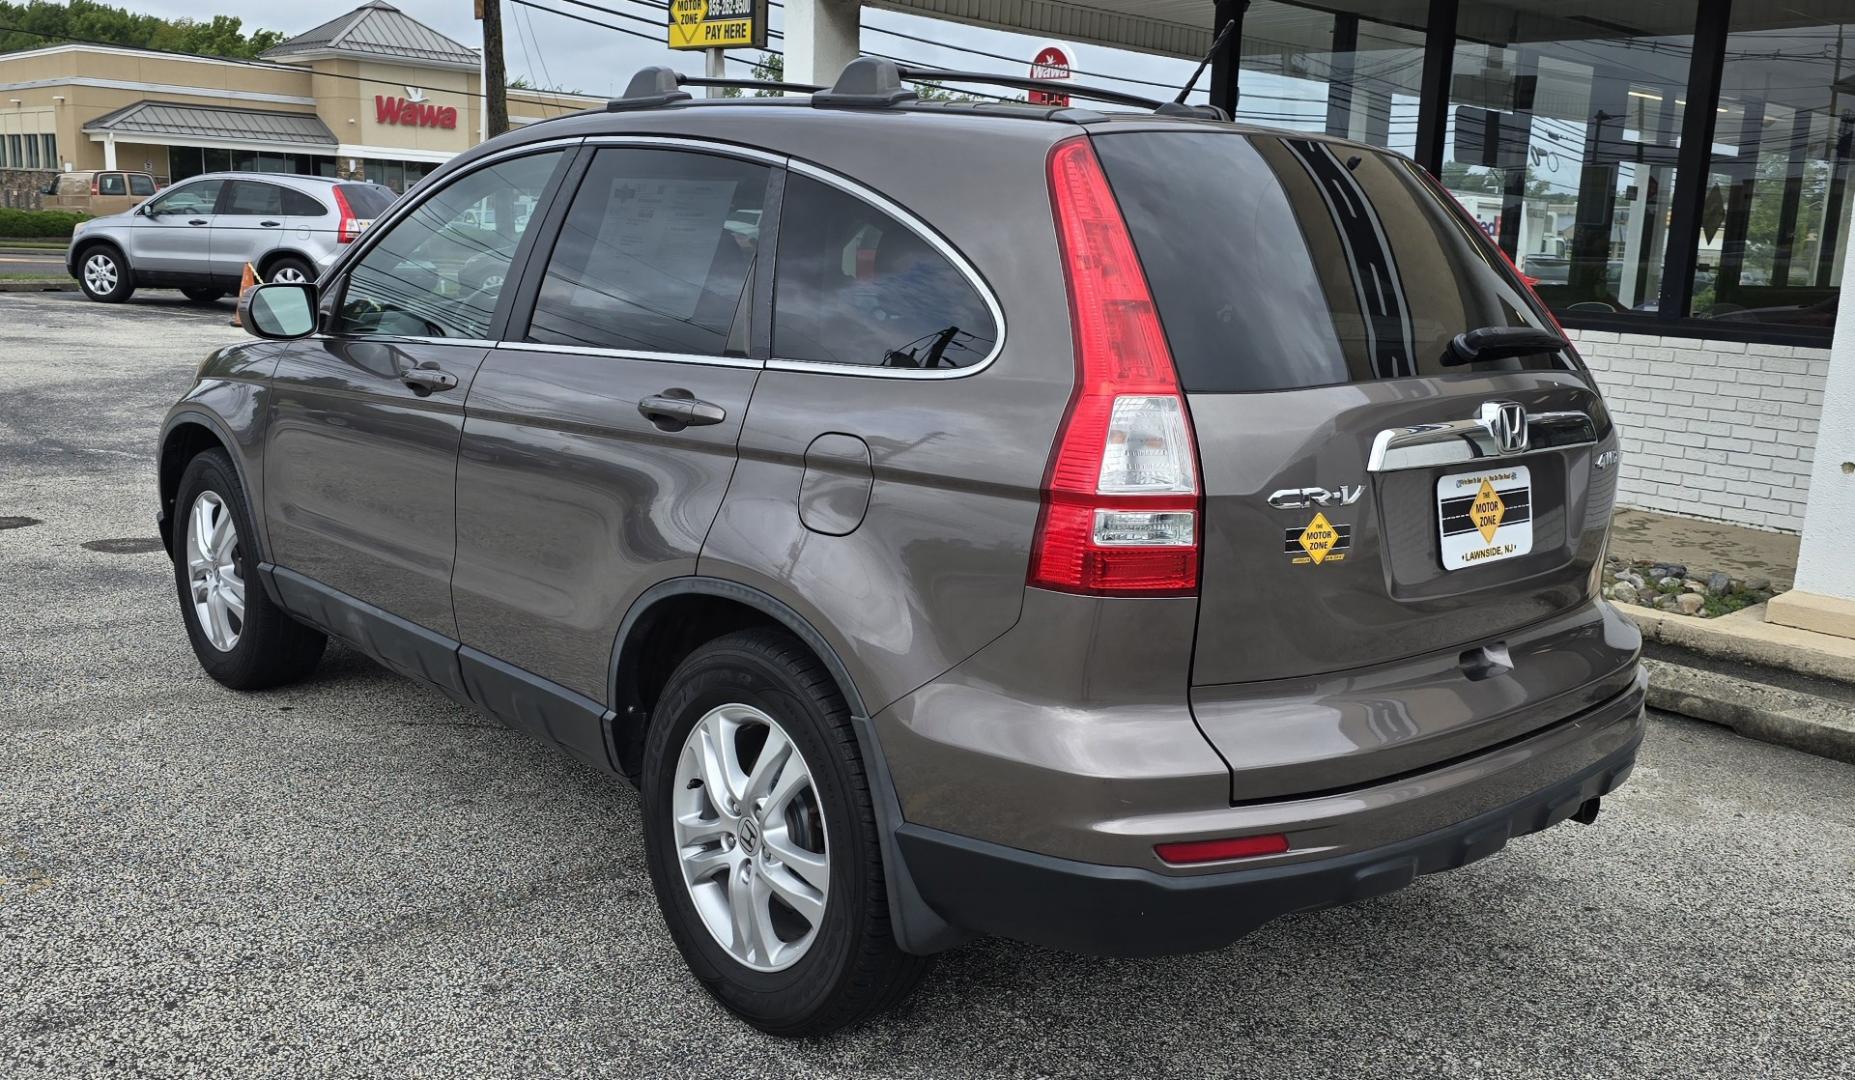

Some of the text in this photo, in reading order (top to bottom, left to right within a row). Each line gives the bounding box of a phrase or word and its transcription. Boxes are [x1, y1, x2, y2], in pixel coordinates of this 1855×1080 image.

[678, 0, 702, 11] MOTOR
[680, 14, 698, 25] ZONE
[705, 23, 747, 40] PAY HERE
[1032, 63, 1068, 79] Wawa
[375, 95, 457, 129] Wawa
[1267, 485, 1366, 509] CR-V
[1476, 501, 1499, 513] MOTOR
[1480, 515, 1497, 527] ZONE
[1306, 530, 1332, 540] MOTOR
[1309, 541, 1328, 550] ZONE
[1465, 544, 1513, 561] LAWNSIDE, NJ
